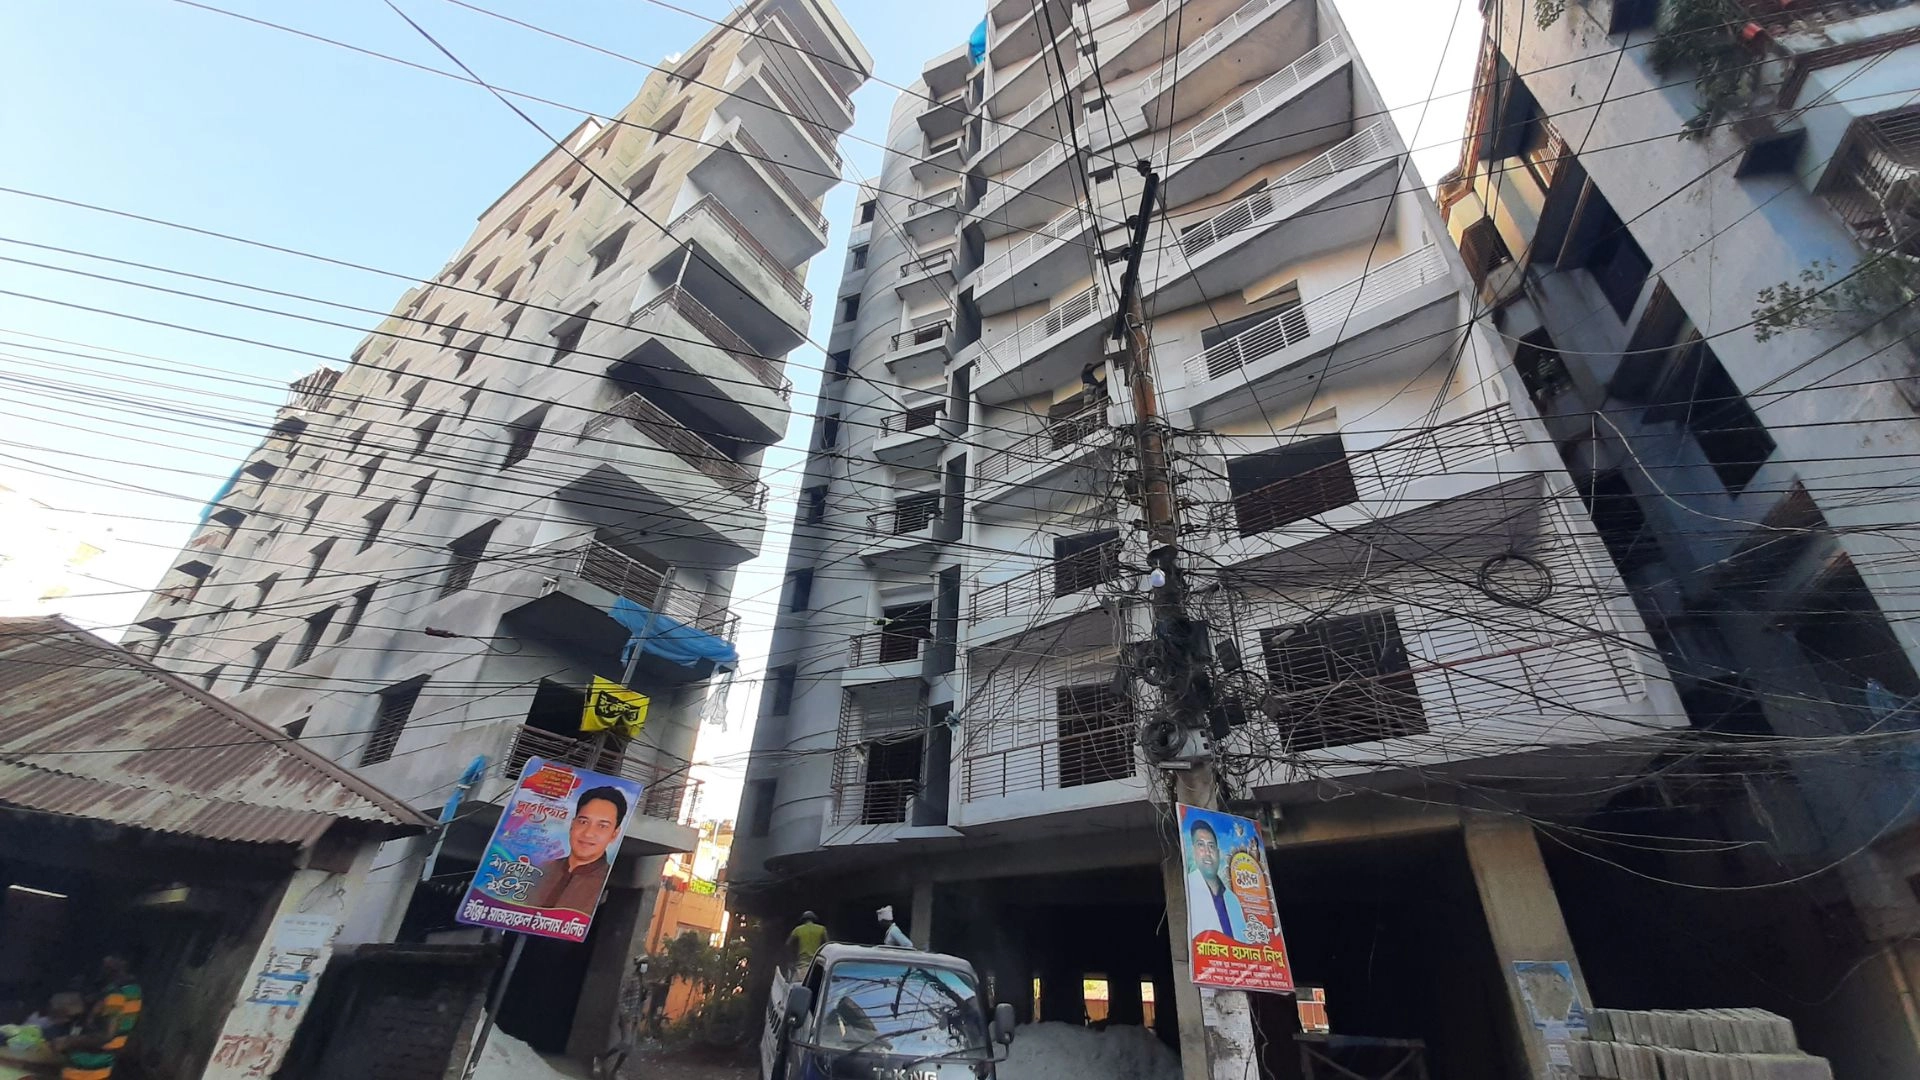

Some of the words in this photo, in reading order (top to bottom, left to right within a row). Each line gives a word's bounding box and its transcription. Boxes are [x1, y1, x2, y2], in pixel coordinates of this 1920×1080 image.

[487, 906, 534, 927] মাজহারুল
[532, 911, 562, 932] ইসলাম
[1196, 938, 1229, 957] রাজিব
[1231, 945, 1261, 962] হাসান
[1263, 945, 1286, 968] নিপু
